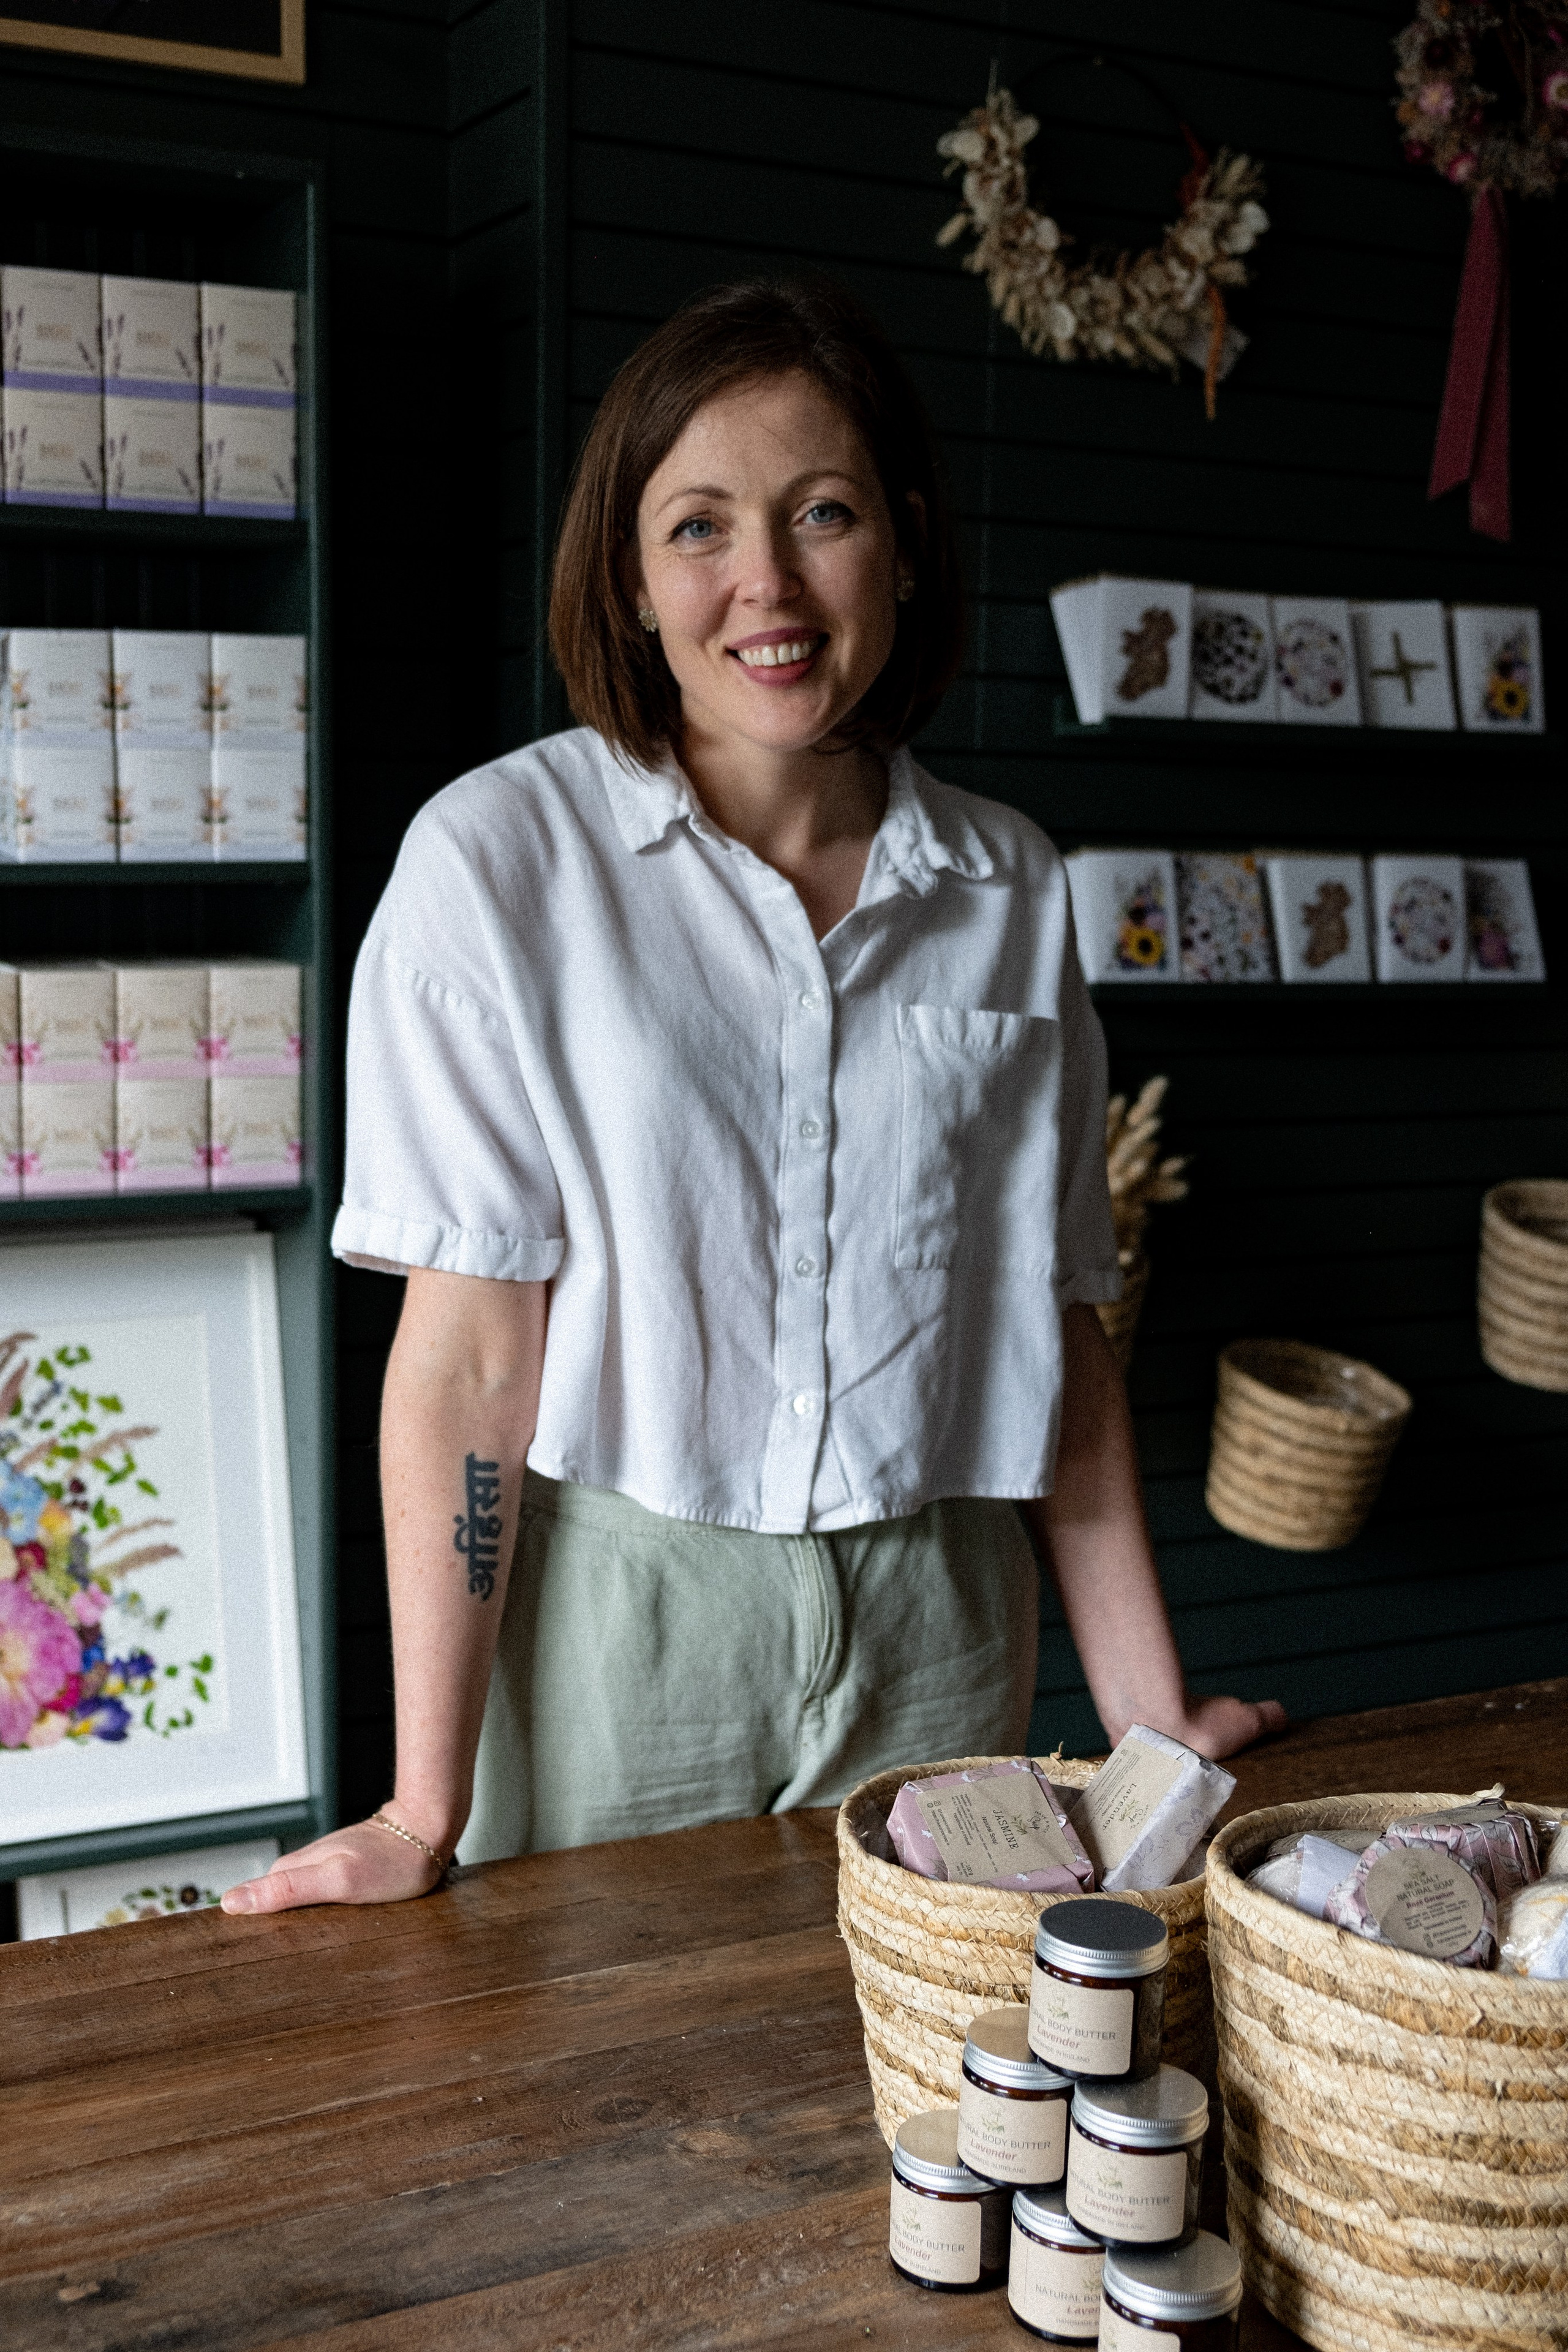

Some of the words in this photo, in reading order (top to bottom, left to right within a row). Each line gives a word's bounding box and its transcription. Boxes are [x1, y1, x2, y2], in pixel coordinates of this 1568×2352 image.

[452, 1450, 503, 1602] अहिंसा
[1112, 1785, 1125, 1803] Natural
[1101, 1804, 1112, 1817] Soap
[1102, 1783, 1137, 1831] Lavender
[982, 1816, 993, 1833] Natural
[989, 1832, 998, 1845] Soap
[993, 1809, 1019, 1849] JASMINE
[1396, 1886, 1431, 1901] NATURAL
[1433, 1879, 1455, 1891] SOAP
[1403, 1881, 1419, 1890] SEA
[1420, 1874, 1439, 1885] SALT
[1423, 1891, 1455, 1904] Geranium
[1036, 2024, 1080, 2049] Lavender
[1047, 2018, 1072, 2034] BODY
[1074, 2028, 1117, 2040] BUTTER
[970, 2138, 1017, 2162] Lavender
[982, 2132, 1008, 2147] BODY
[1011, 2140, 1051, 2150] BUTTER
[1084, 2195, 1136, 2218] Lavender
[1097, 2187, 1124, 2204] BODY
[1129, 2195, 1170, 2206] BUTTER
[894, 2234, 932, 2261] Lavender
[926, 2240, 966, 2253] BUTTER
[1035, 2283, 1080, 2303] NATURAL
[1067, 2305, 1101, 2316] Laven
